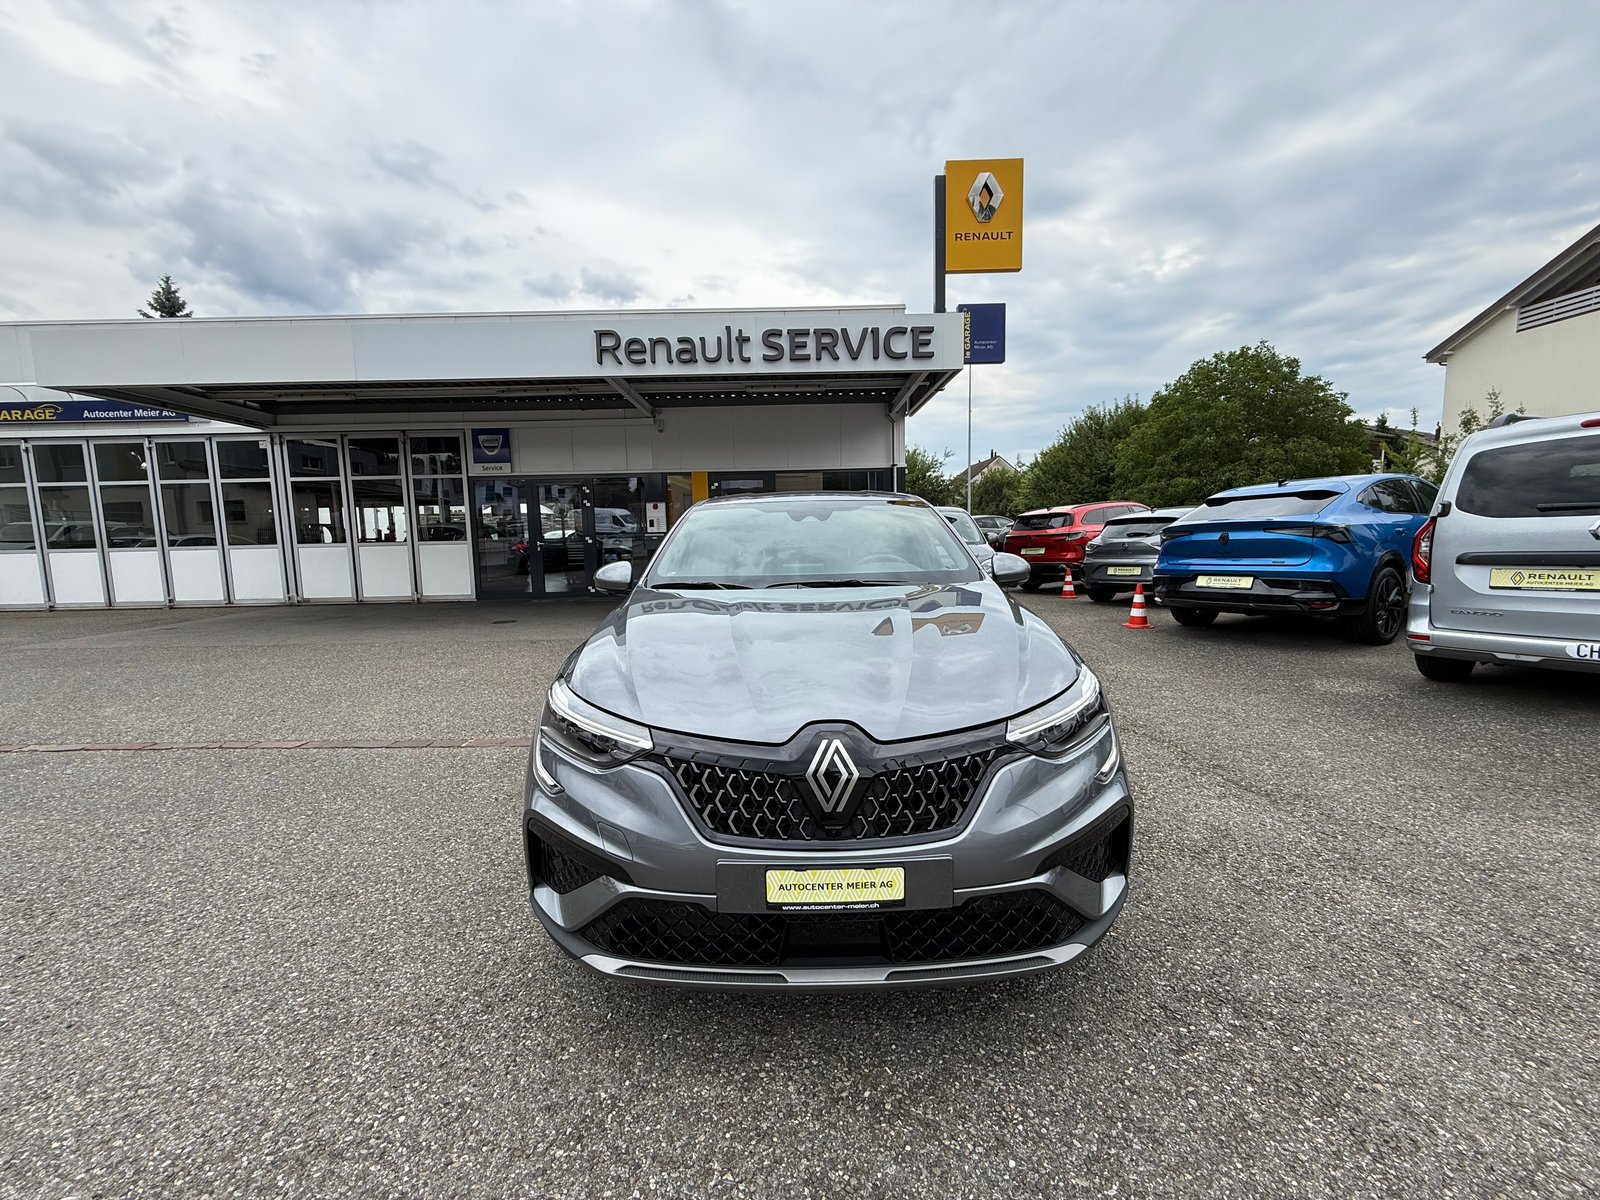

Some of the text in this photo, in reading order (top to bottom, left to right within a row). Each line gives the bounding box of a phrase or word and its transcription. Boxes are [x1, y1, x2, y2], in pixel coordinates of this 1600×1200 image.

[954, 231, 1014, 241] RENAULT
[593, 326, 936, 366] Renault SERVICE
[83, 409, 132, 418] Autocenter
[134, 408, 160, 417] Meier
[1528, 573, 1595, 581] RENAULT
[1576, 643, 1600, 659] CH
[778, 880, 893, 891] AUTOCENTER MEIER AG
[782, 903, 880, 911] www.autocenter-meier.ch
